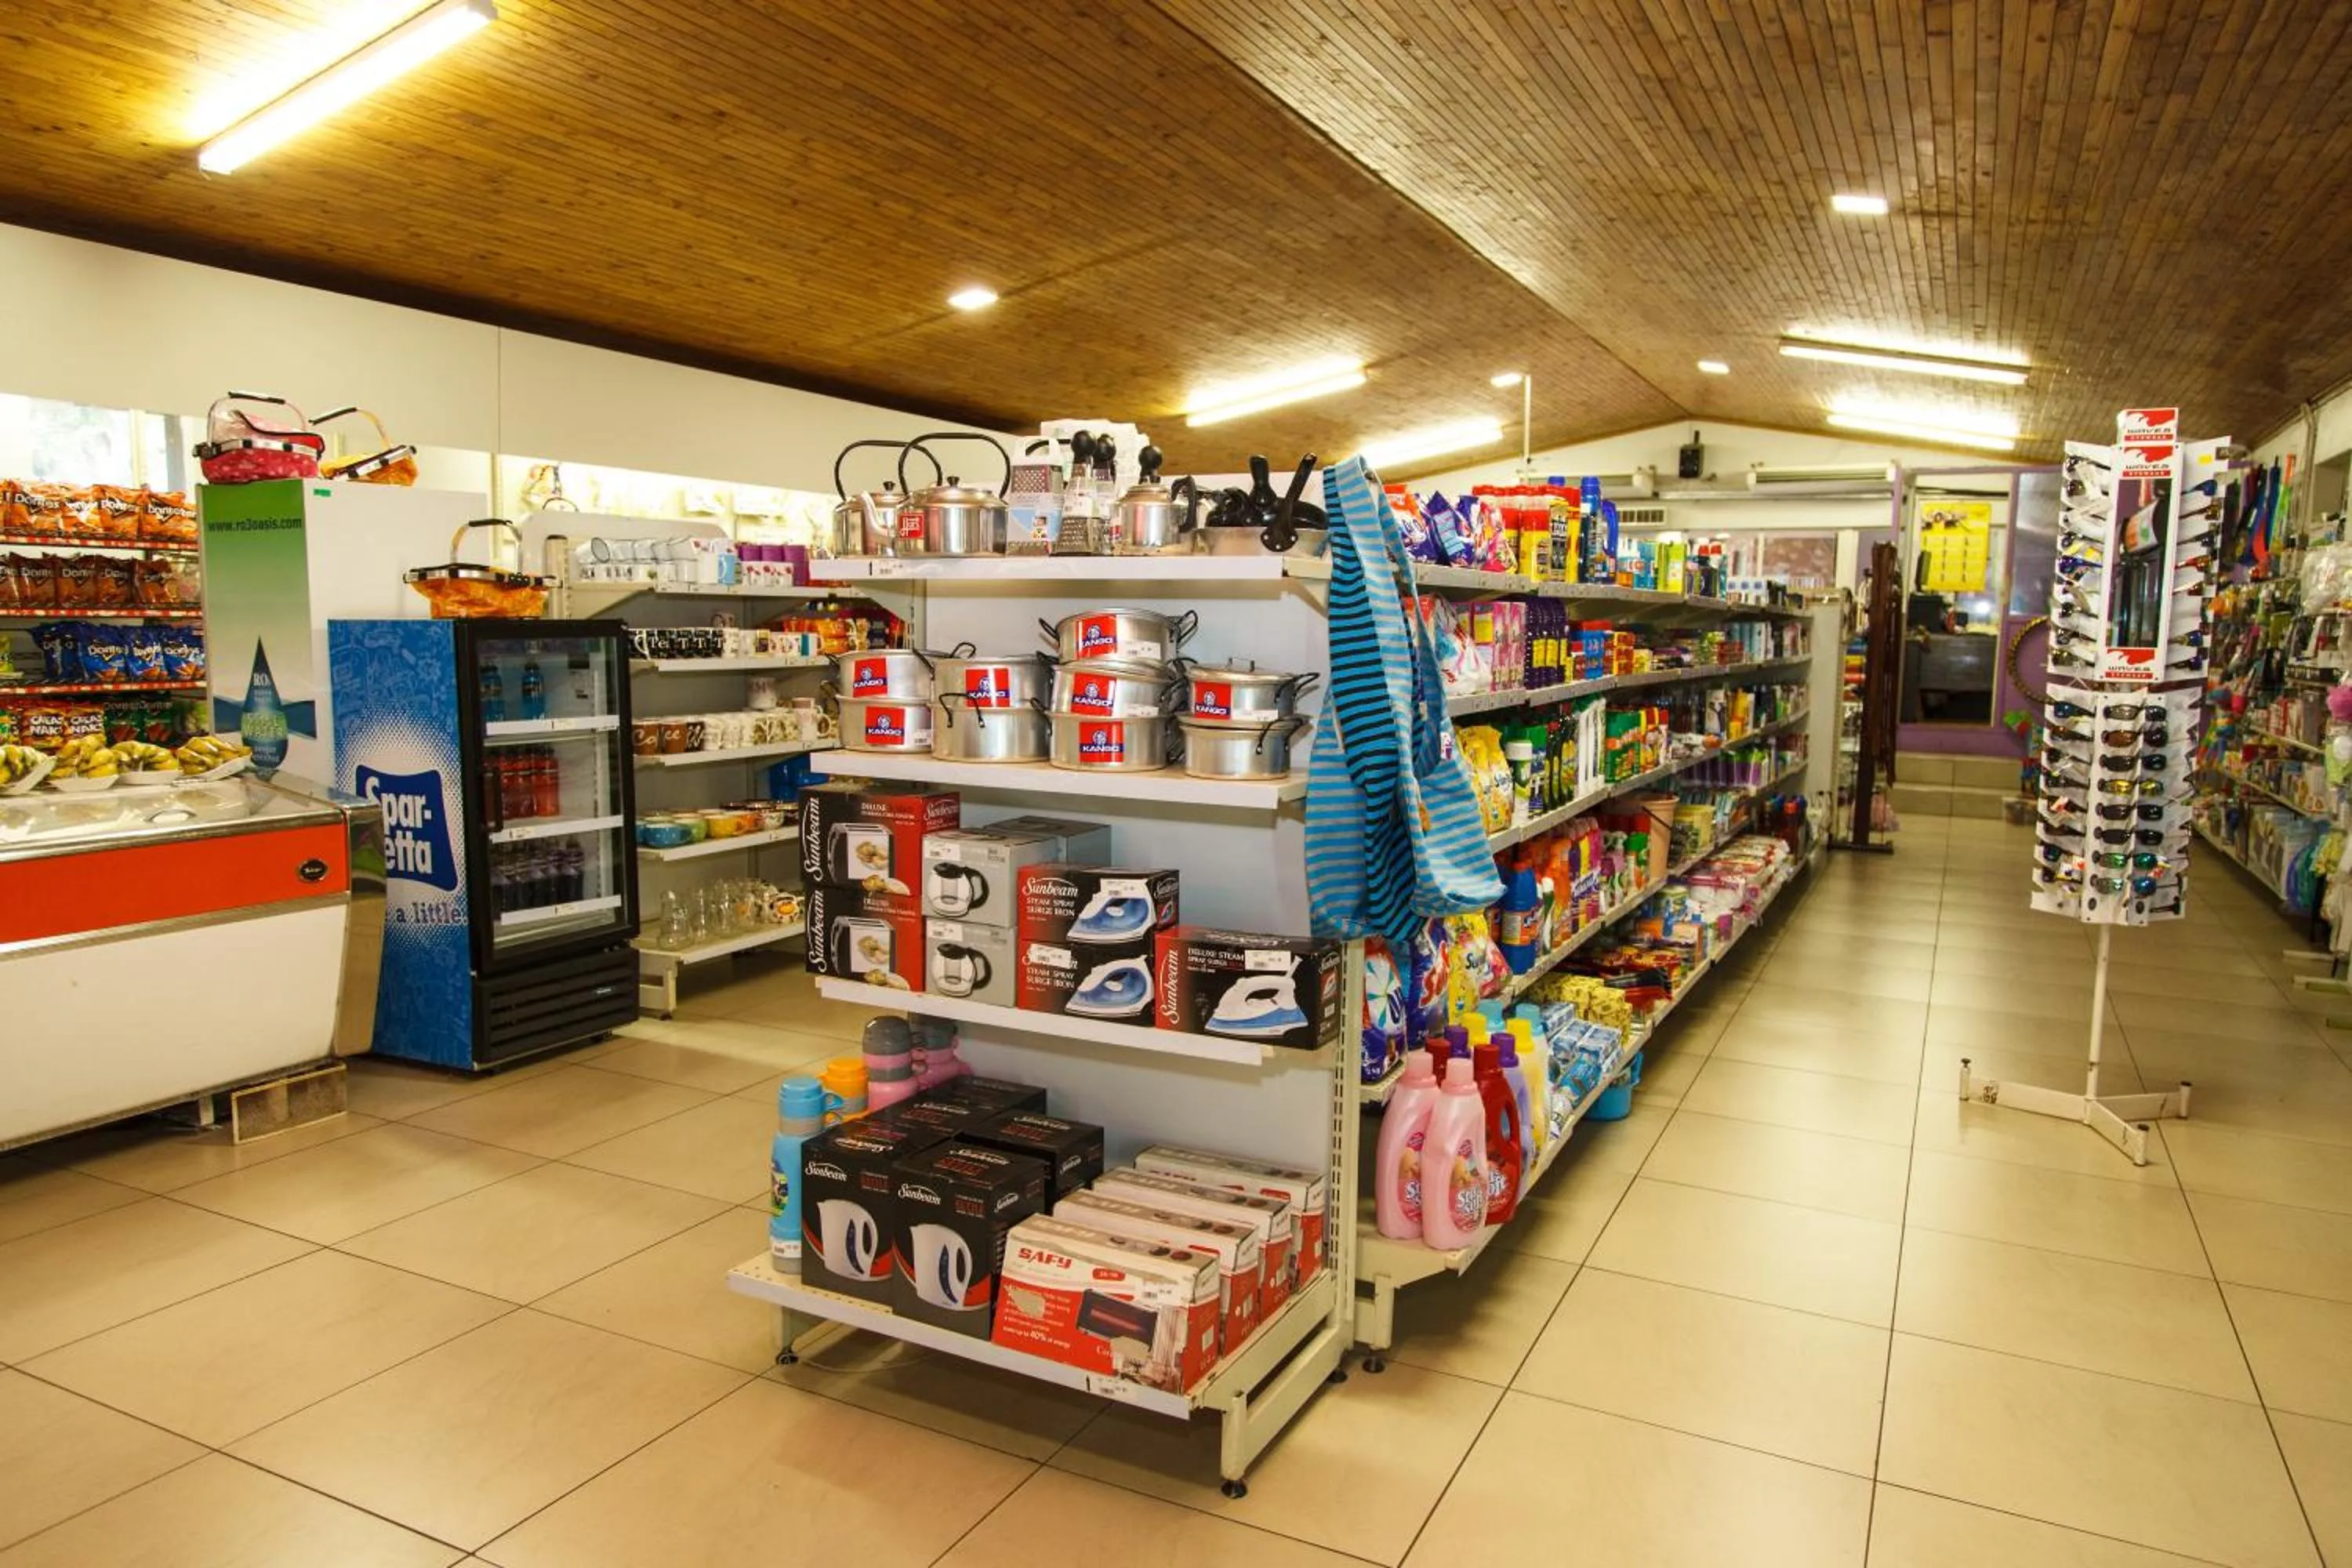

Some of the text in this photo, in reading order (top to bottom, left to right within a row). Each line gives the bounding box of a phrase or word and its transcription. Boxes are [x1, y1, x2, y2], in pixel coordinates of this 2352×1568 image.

[1073, 695, 1112, 706] KANGO
[385, 829, 432, 873] etta
[802, 797, 823, 883] Sunbeam
[1022, 877, 1079, 898] Sunbeam
[808, 890, 827, 972] Sunbeam
[1218, 951, 1244, 960] STEAM
[1159, 949, 1179, 1024] Sunbeam
[804, 1160, 848, 1182] Sunbeam
[898, 1183, 941, 1206] Sunbeam
[1018, 1247, 1073, 1269] SAFY
